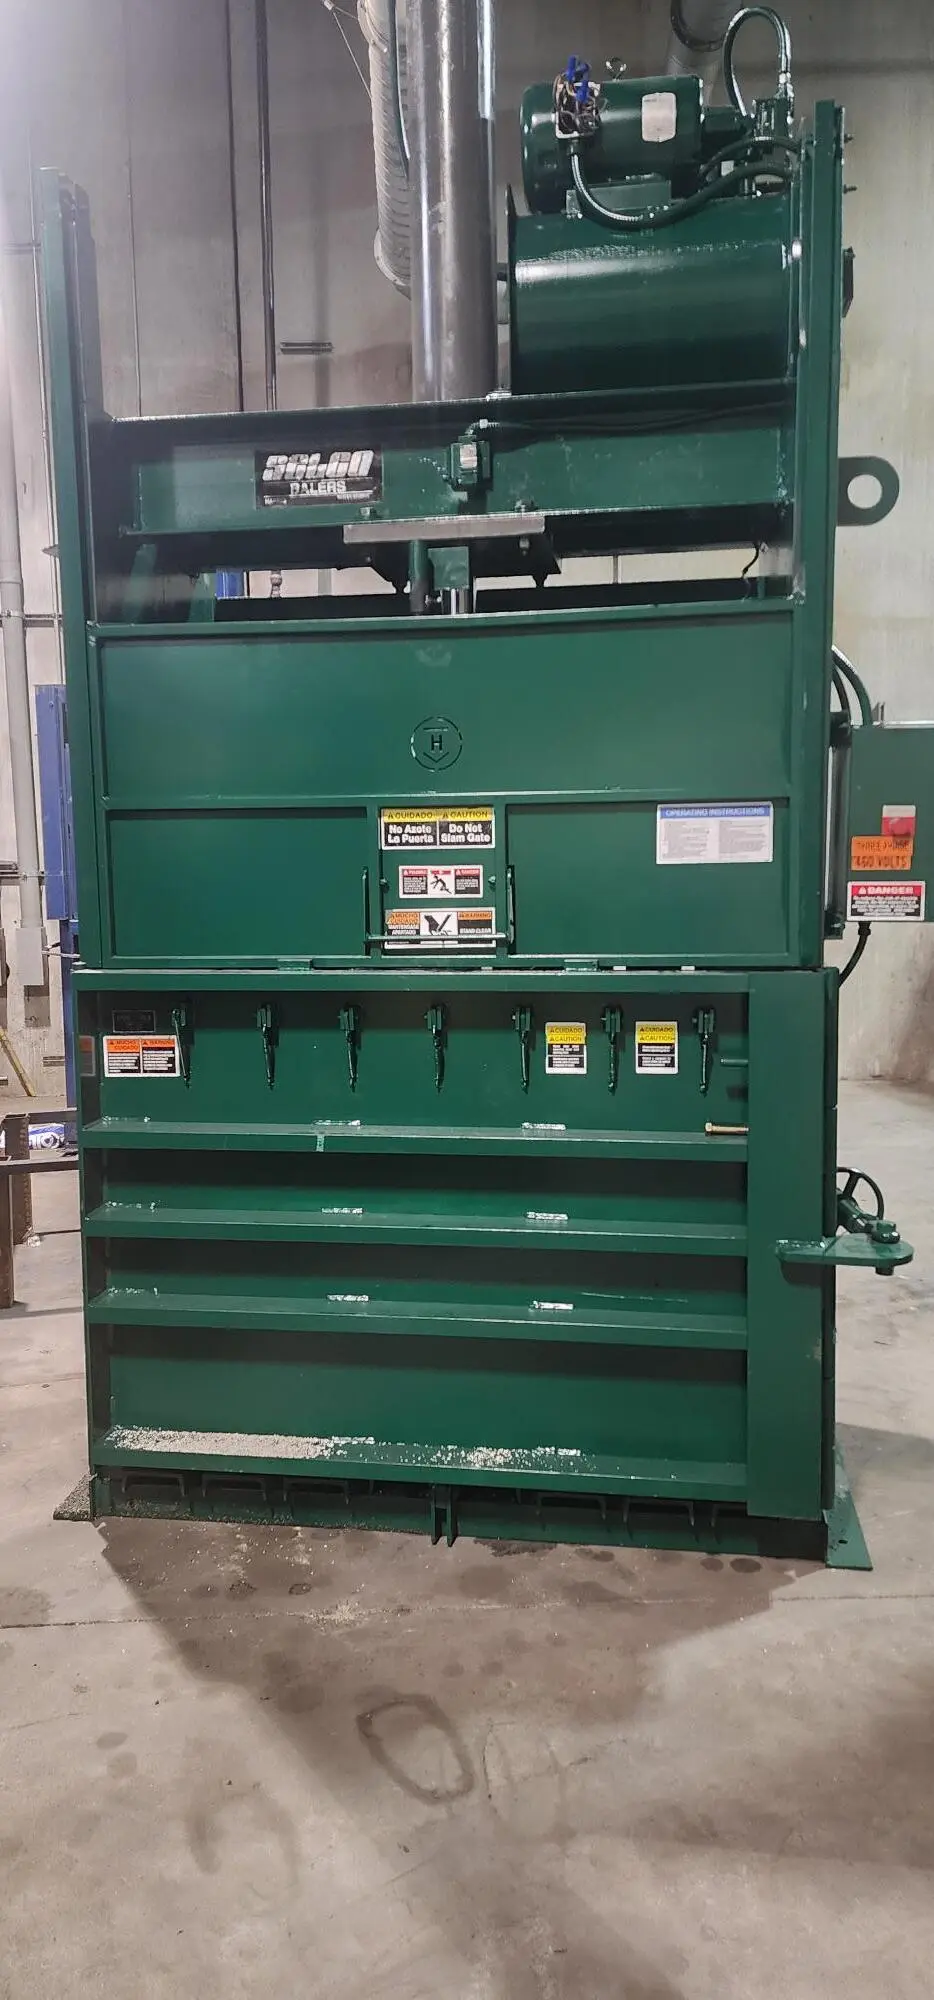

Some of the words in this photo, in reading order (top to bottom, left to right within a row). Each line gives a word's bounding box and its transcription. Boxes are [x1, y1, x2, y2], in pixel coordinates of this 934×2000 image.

[395, 811, 434, 819] CUIDADO
[450, 810, 488, 818] CAUTION
[665, 808, 708, 817] OPERATING
[709, 807, 765, 816] INSTRUCTIONS
[388, 824, 403, 834] No
[404, 824, 432, 834] Azote
[448, 823, 463, 833] Do
[464, 823, 483, 833] Not
[387, 834, 400, 843] La
[401, 834, 434, 843] Puerta
[441, 833, 465, 843] Slam
[467, 833, 491, 843] Gate
[878, 855, 907, 868] VOLTS
[867, 886, 914, 895] DANGER
